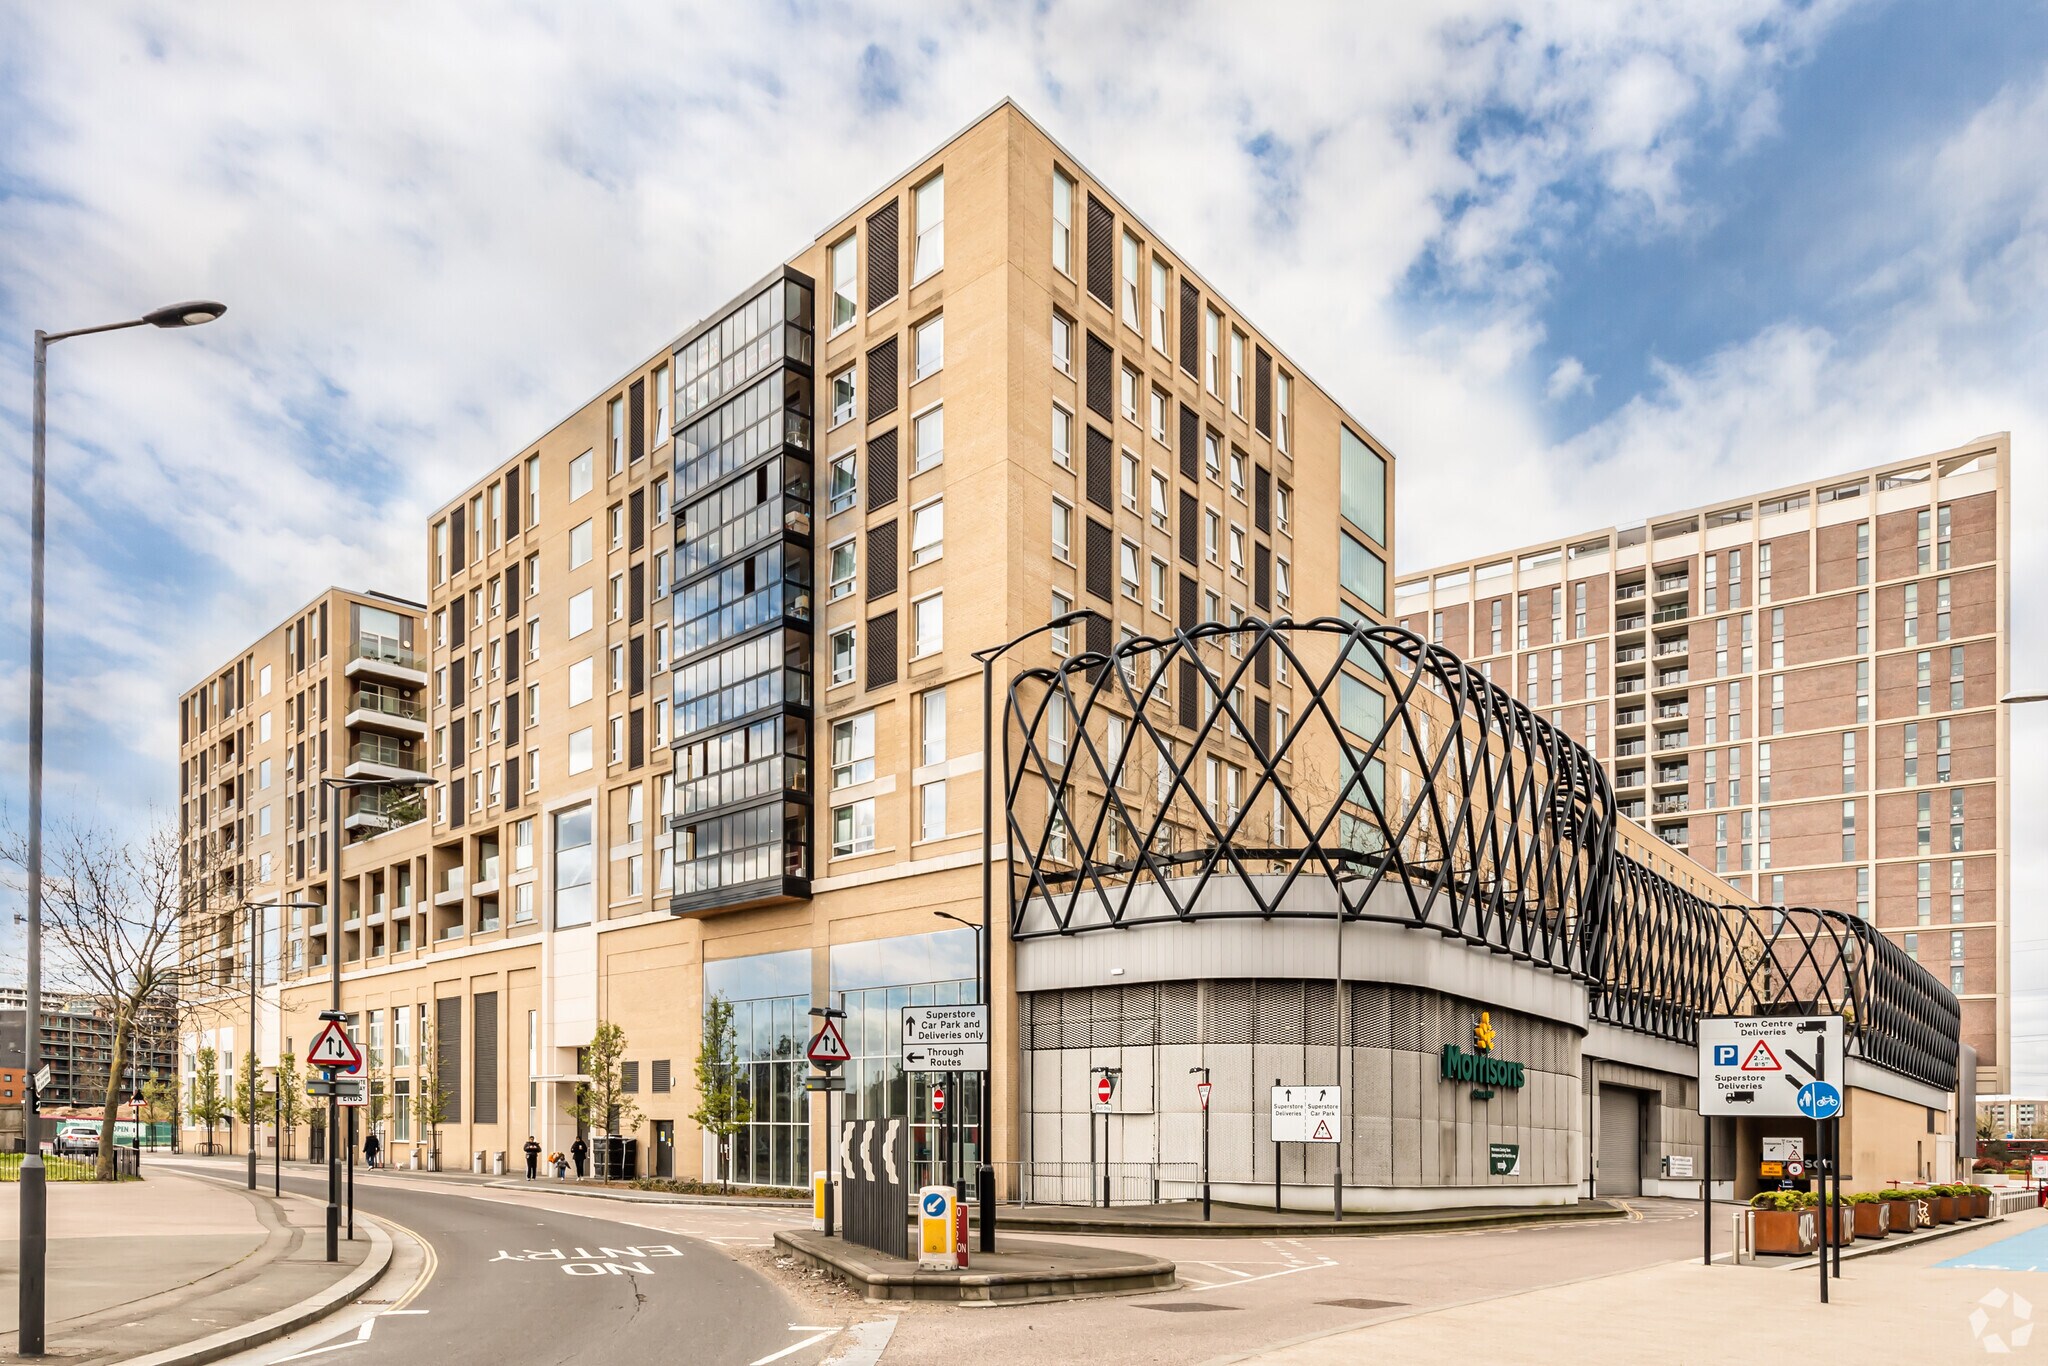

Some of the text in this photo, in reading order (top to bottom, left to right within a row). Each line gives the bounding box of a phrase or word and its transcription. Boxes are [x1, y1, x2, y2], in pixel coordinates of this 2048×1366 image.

[926, 1010, 976, 1020] Superstore
[921, 1020, 980, 1029] Car Park and
[1761, 1020, 1793, 1028] Centre
[918, 1030, 984, 1040] Deliveries only
[927, 1048, 964, 1057] Through
[1720, 1047, 1735, 1064] P
[930, 1058, 962, 1066] Routes
[1444, 1043, 1525, 1088] Morrisons
[1714, 1074, 1766, 1083] Superstore
[1718, 1082, 1763, 1090] Deliveries
[489, 1245, 684, 1262] ENTRY
[560, 1262, 655, 1276] NO
